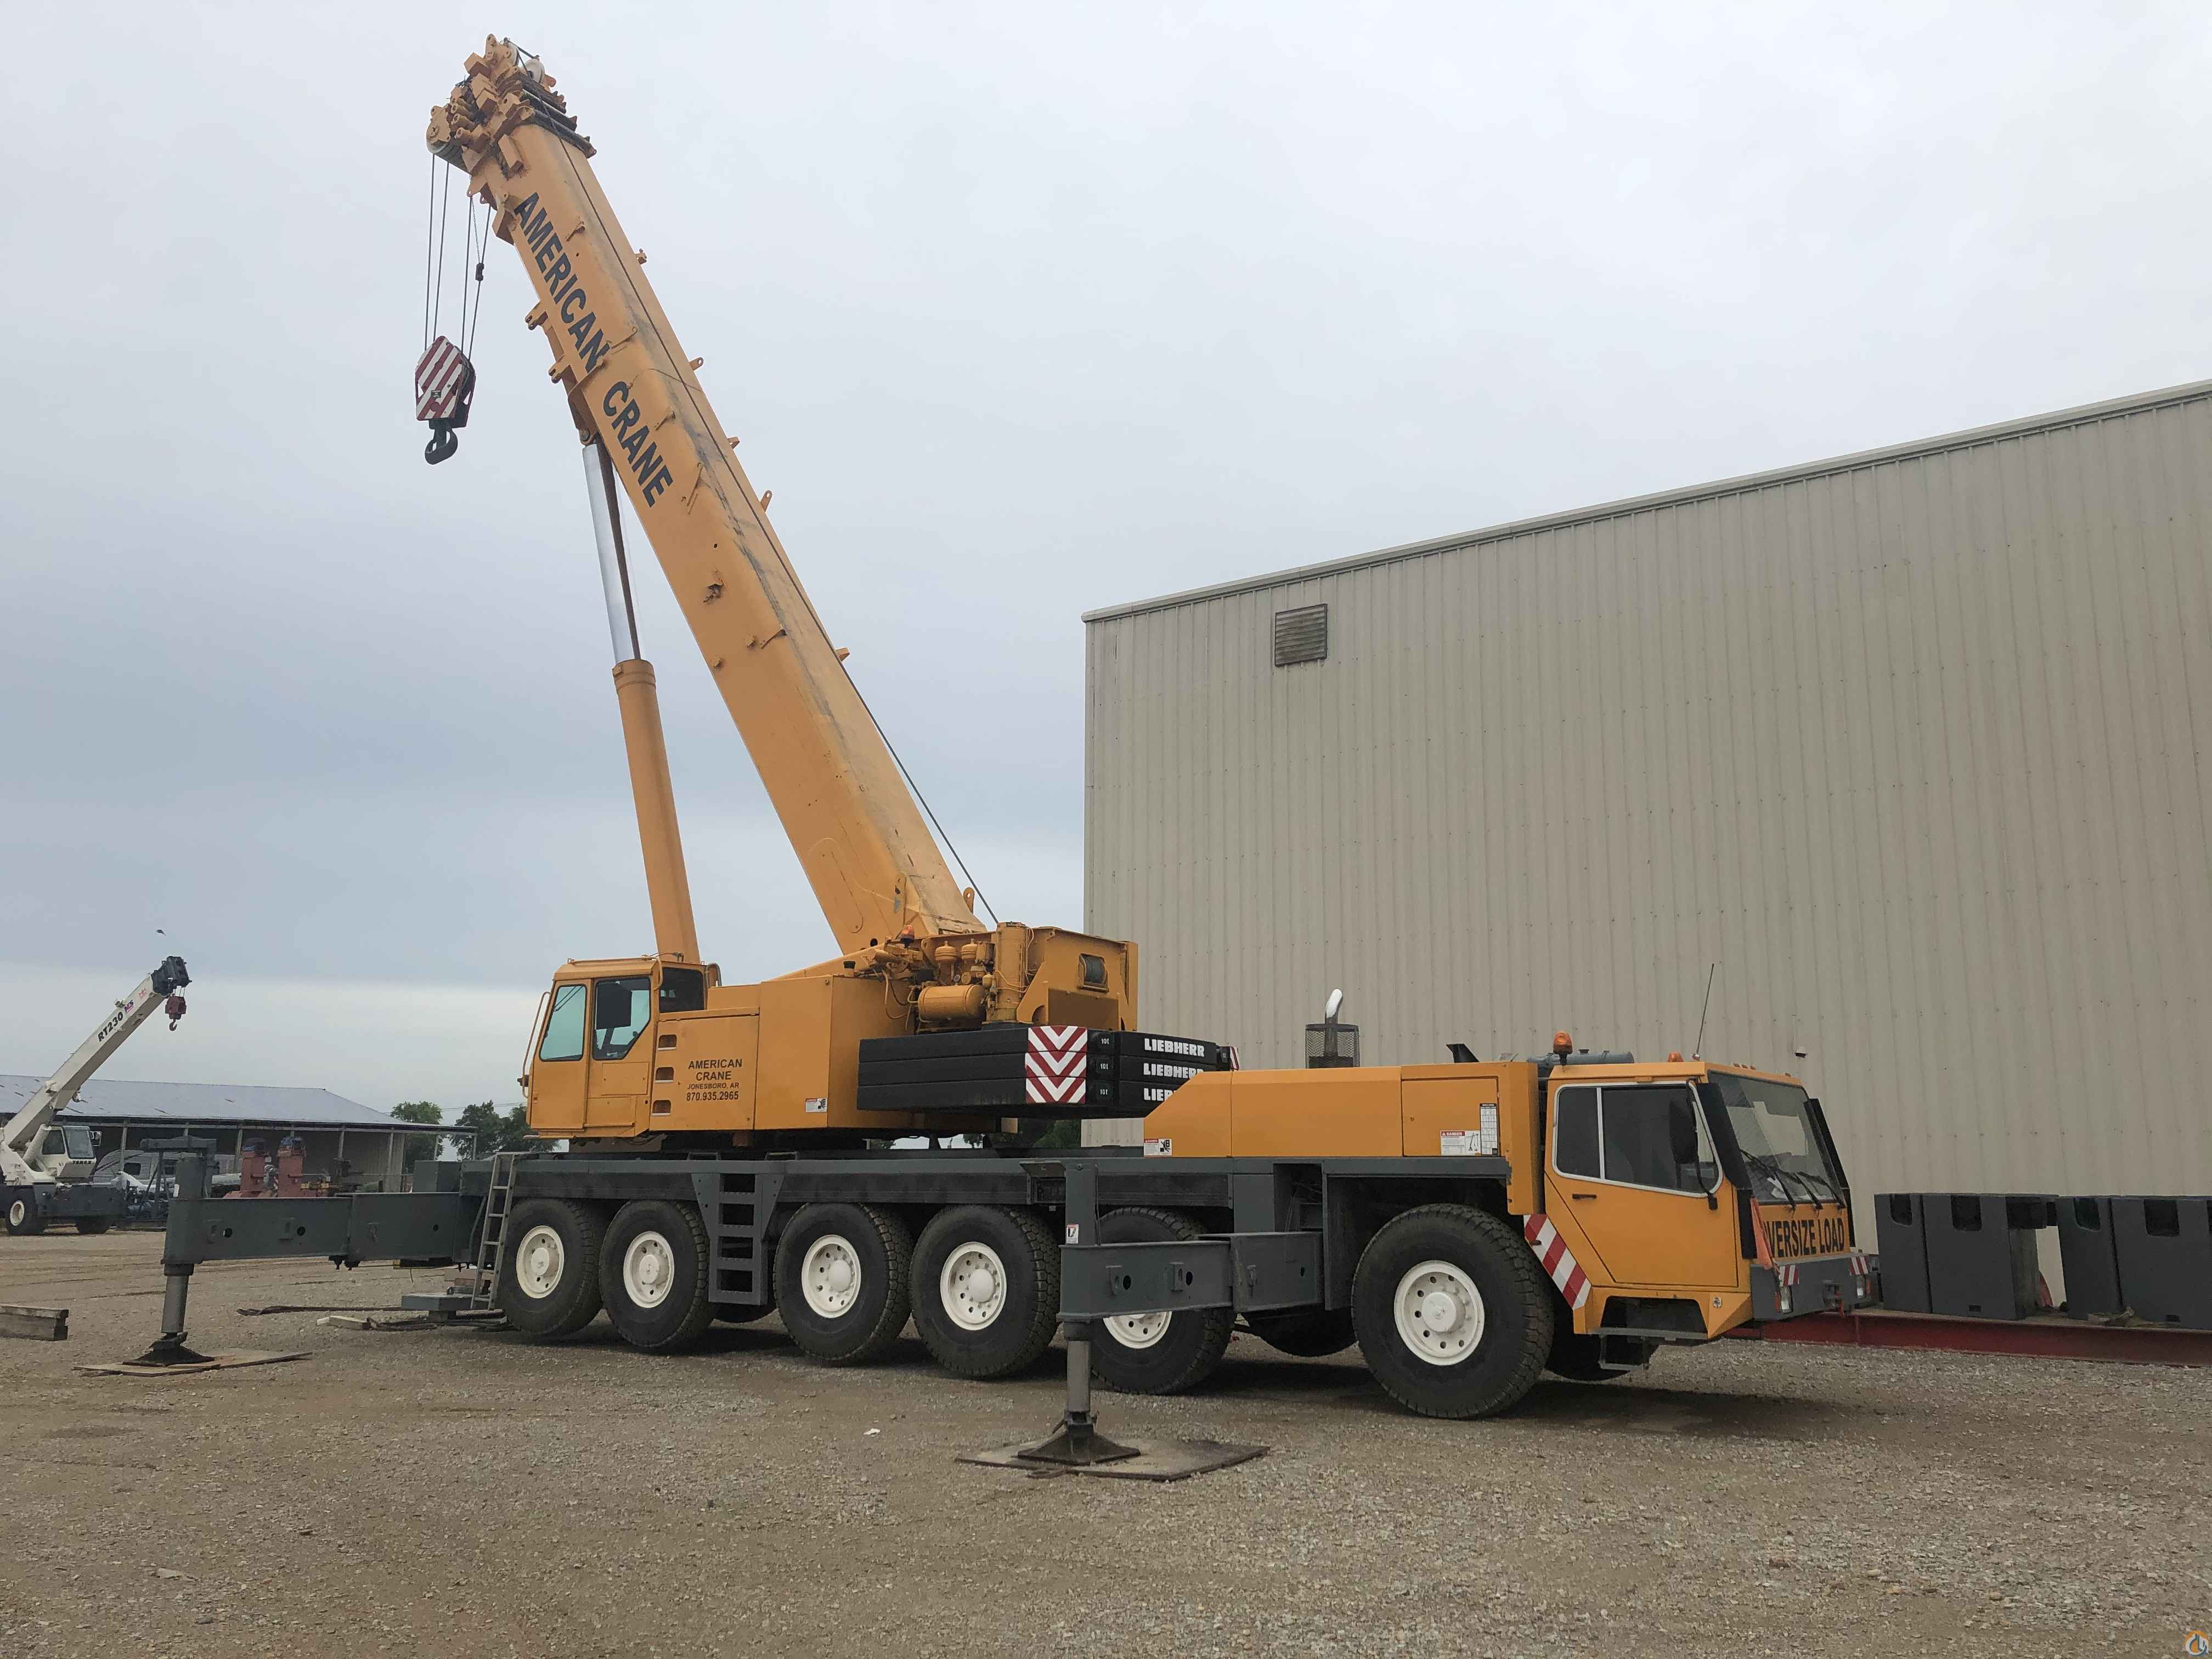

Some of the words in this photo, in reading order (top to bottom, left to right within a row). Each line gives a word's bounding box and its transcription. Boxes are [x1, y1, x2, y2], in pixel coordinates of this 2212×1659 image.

[514, 191, 611, 373] AMERICAN
[603, 381, 674, 508] CRANE
[97, 1011, 123, 1042] RT230
[1144, 1038, 1205, 1057] LIEBHERR
[688, 1058, 742, 1070] AMERICAN
[696, 1071, 732, 1081] CRANE
[686, 1091, 739, 1102] 870.935.2965
[1763, 1219, 1817, 1259] VERSIZE
[1818, 1217, 1845, 1254] LOAD
